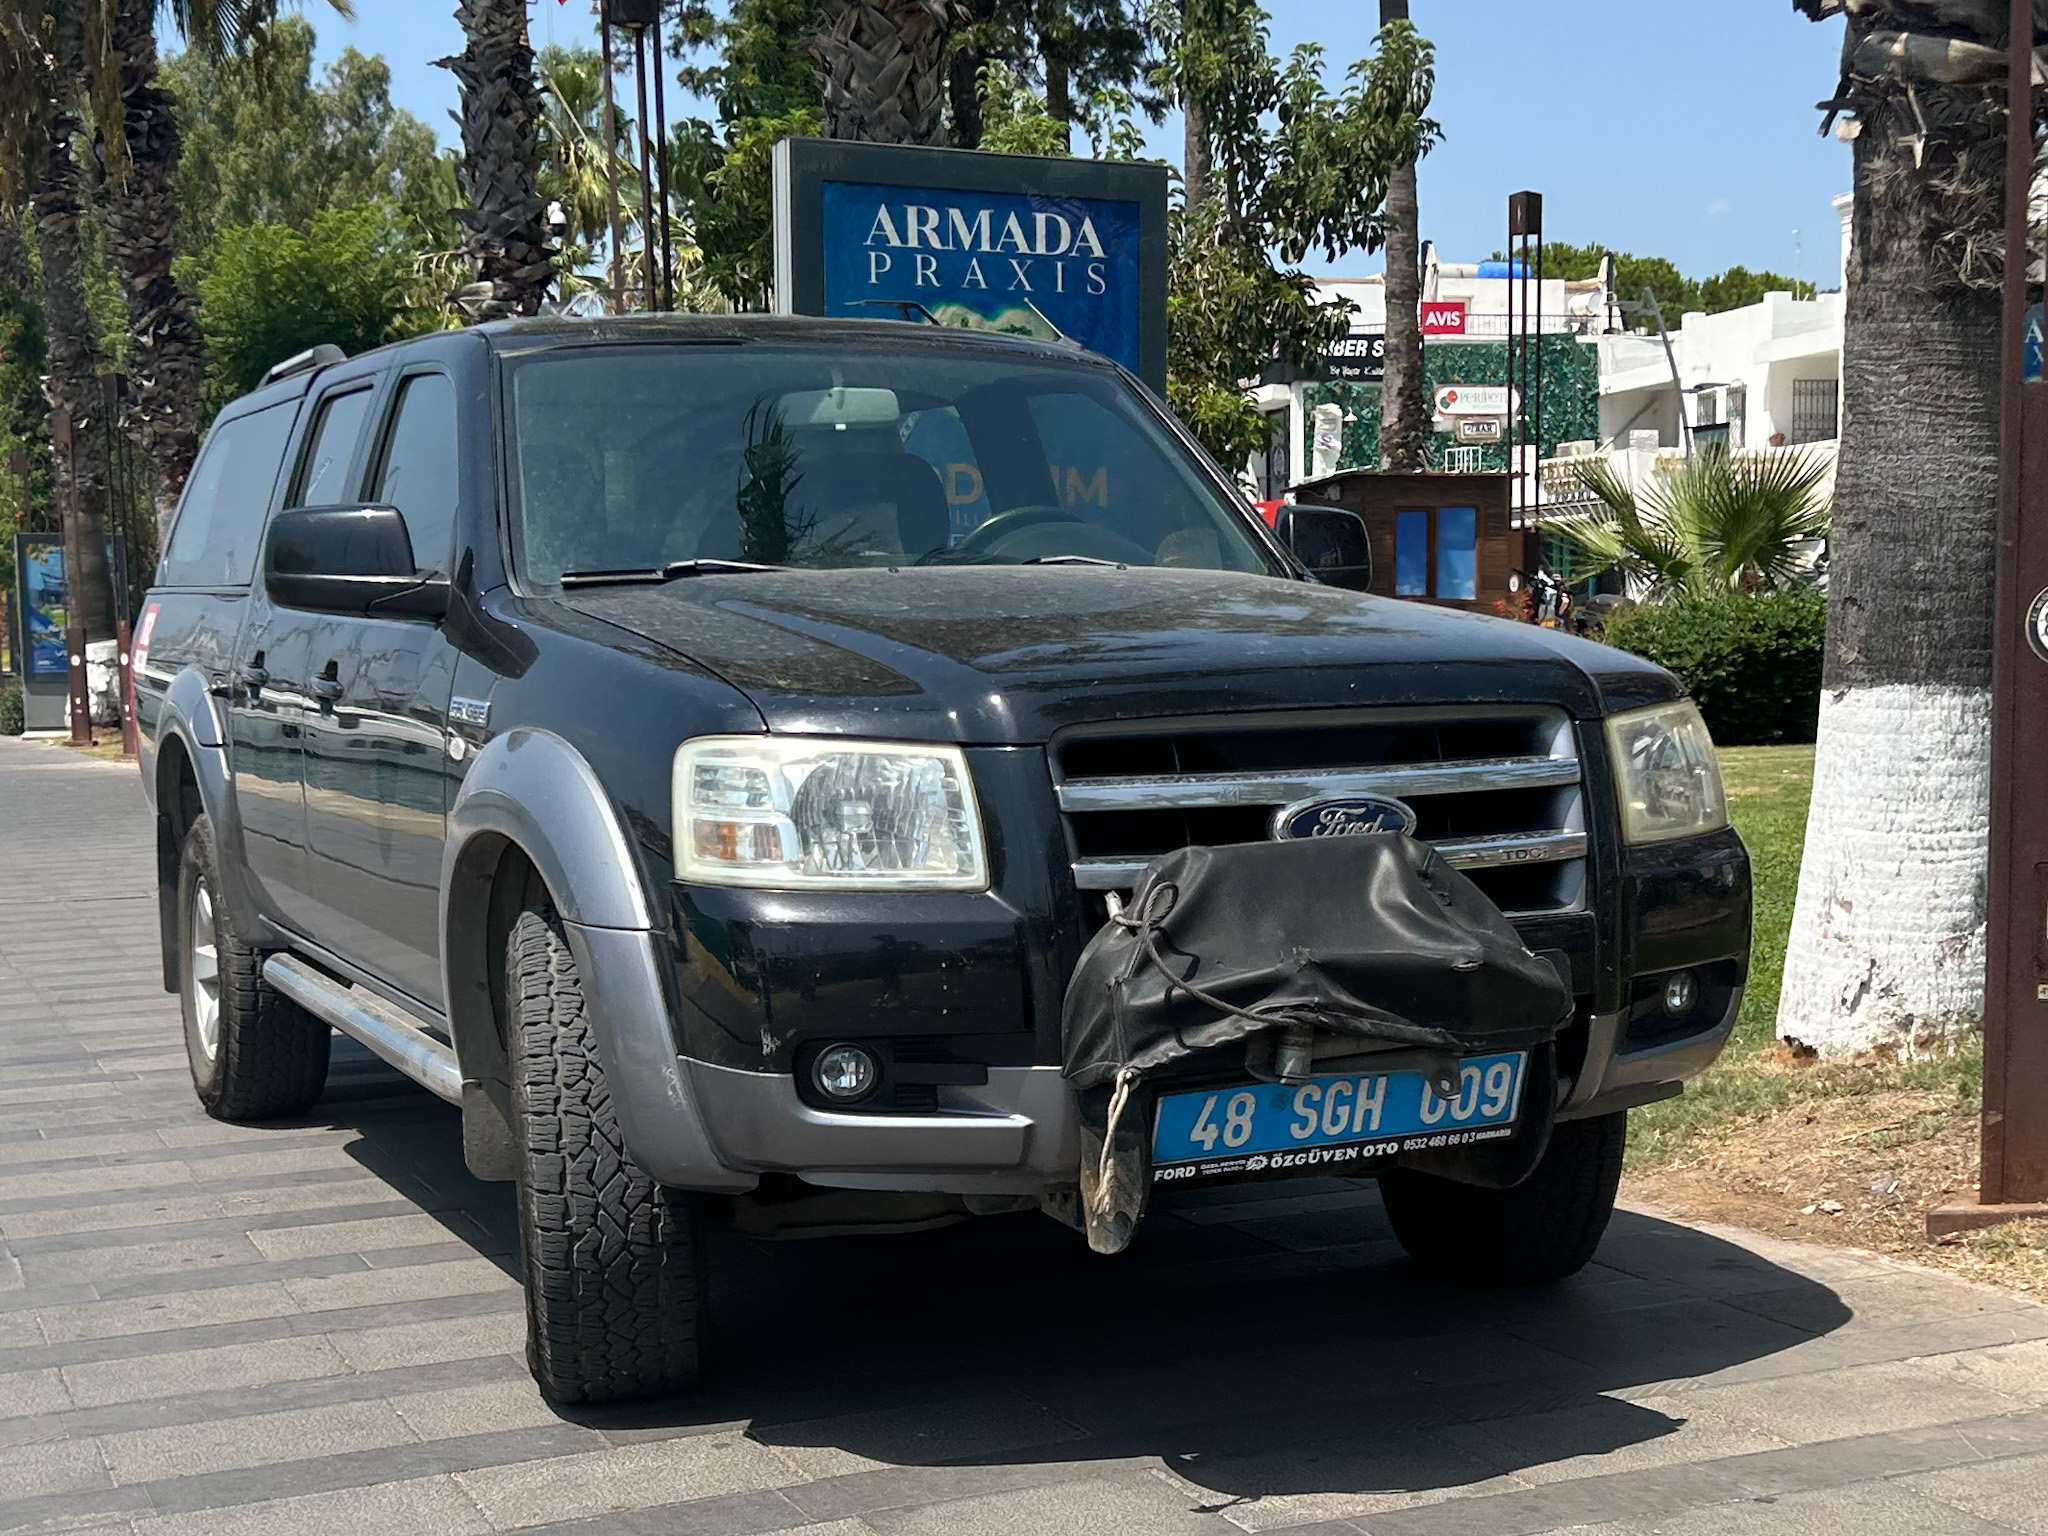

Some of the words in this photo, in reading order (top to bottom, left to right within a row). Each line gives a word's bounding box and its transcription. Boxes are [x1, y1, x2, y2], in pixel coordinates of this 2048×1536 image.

[863, 203, 1108, 259] ARMADA
[868, 251, 1106, 295] PRAXIS
[1425, 310, 1461, 327] AVIS
[1312, 807, 1384, 838] Ford
[1502, 846, 1549, 861] TDCi
[1190, 1092, 1256, 1151] 48
[1290, 1076, 1387, 1140] SGH
[1270, 1146, 1359, 1168] ÖZGÜVEN
[1363, 1142, 1399, 1157] OTO
[1403, 1138, 1427, 1151] 0532
[1154, 1166, 1196, 1182] FORD
